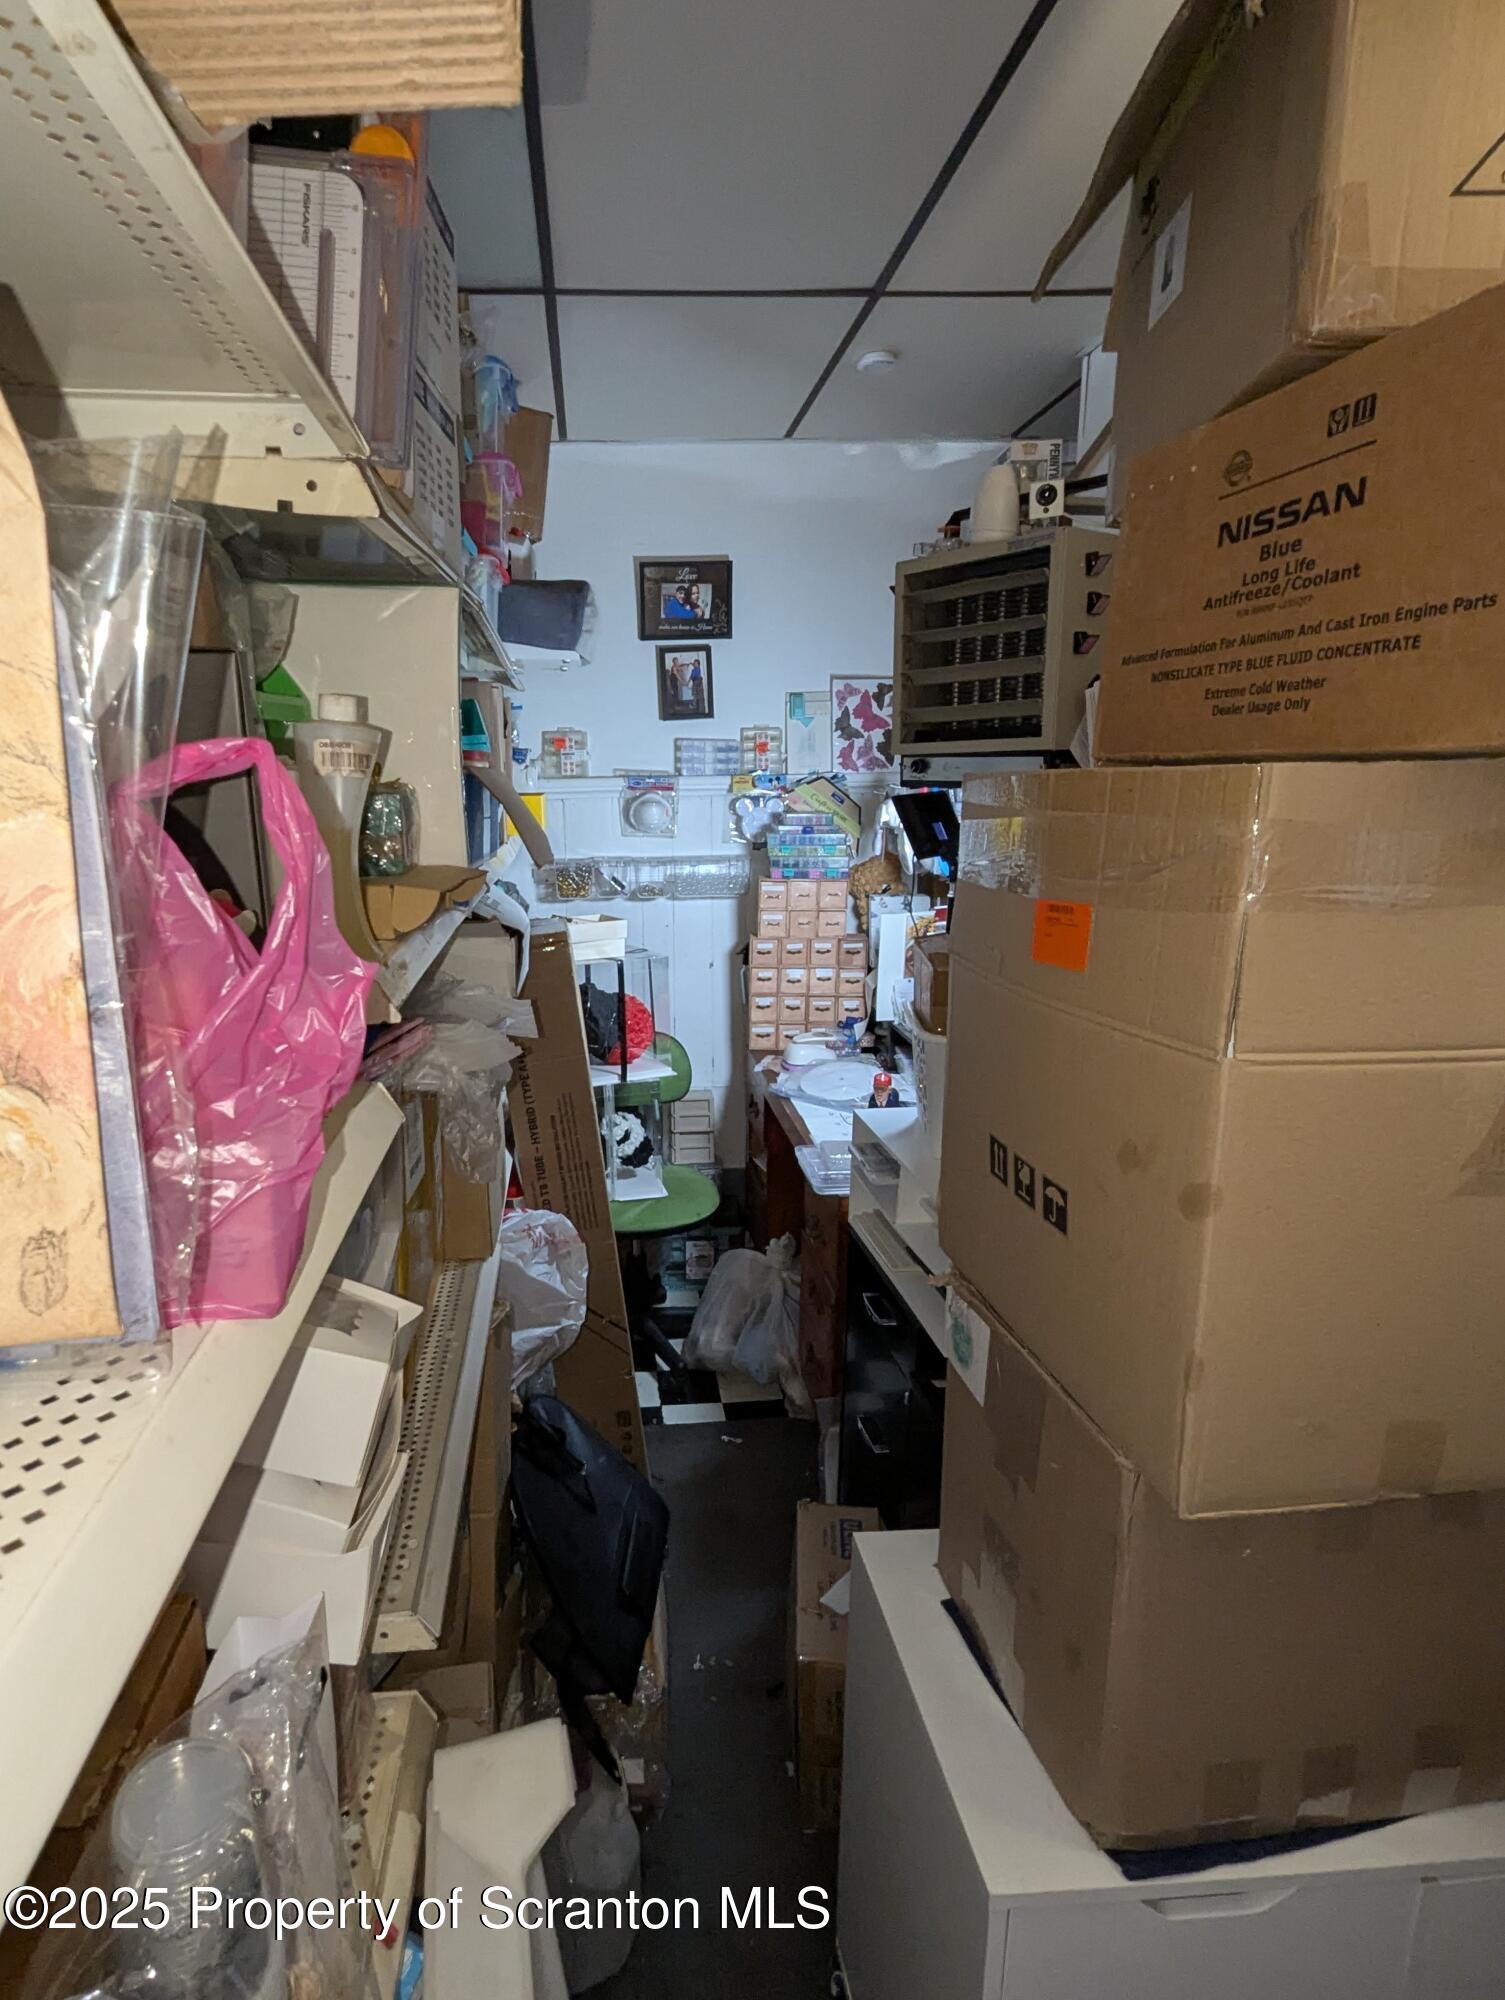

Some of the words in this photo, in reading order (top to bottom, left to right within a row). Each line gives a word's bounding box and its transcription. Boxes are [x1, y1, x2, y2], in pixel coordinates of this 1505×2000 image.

[302, 183, 312, 248] FISKARS
[1217, 476, 1368, 548] NISSAN
[1259, 538, 1303, 562] Blue
[1203, 562, 1361, 612] Antifreeze/Coolant
[1242, 569, 1279, 587] Long
[1285, 557, 1316, 577] Life
[1121, 650, 1159, 666] Advanced
[1160, 641, 1217, 660] Formulation
[1220, 638, 1236, 648] For
[1239, 629, 1295, 647] Aluminum
[1298, 621, 1322, 637] And
[1326, 617, 1355, 632] Cast
[1358, 613, 1390, 628] Iron
[1395, 602, 1449, 623] Engine
[1453, 593, 1499, 614] Parts
[1151, 664, 1215, 683] NONSILICATE
[1218, 659, 1243, 675] TYPE
[1245, 655, 1274, 671] BLUE
[1276, 650, 1312, 668] FLUID
[1316, 634, 1422, 662] CONCENTRATE
[1204, 686, 1246, 701] Extreme
[1248, 680, 1273, 696] Cold
[1276, 677, 1327, 692] Weather
[1212, 700, 1245, 717] Dealer
[1247, 700, 1281, 716] Usage
[1284, 697, 1311, 712] Only
[519, 1073, 535, 1104] (TYPE
[526, 1107, 540, 1145] HYBRID
[534, 1155, 546, 1182] TUBE
